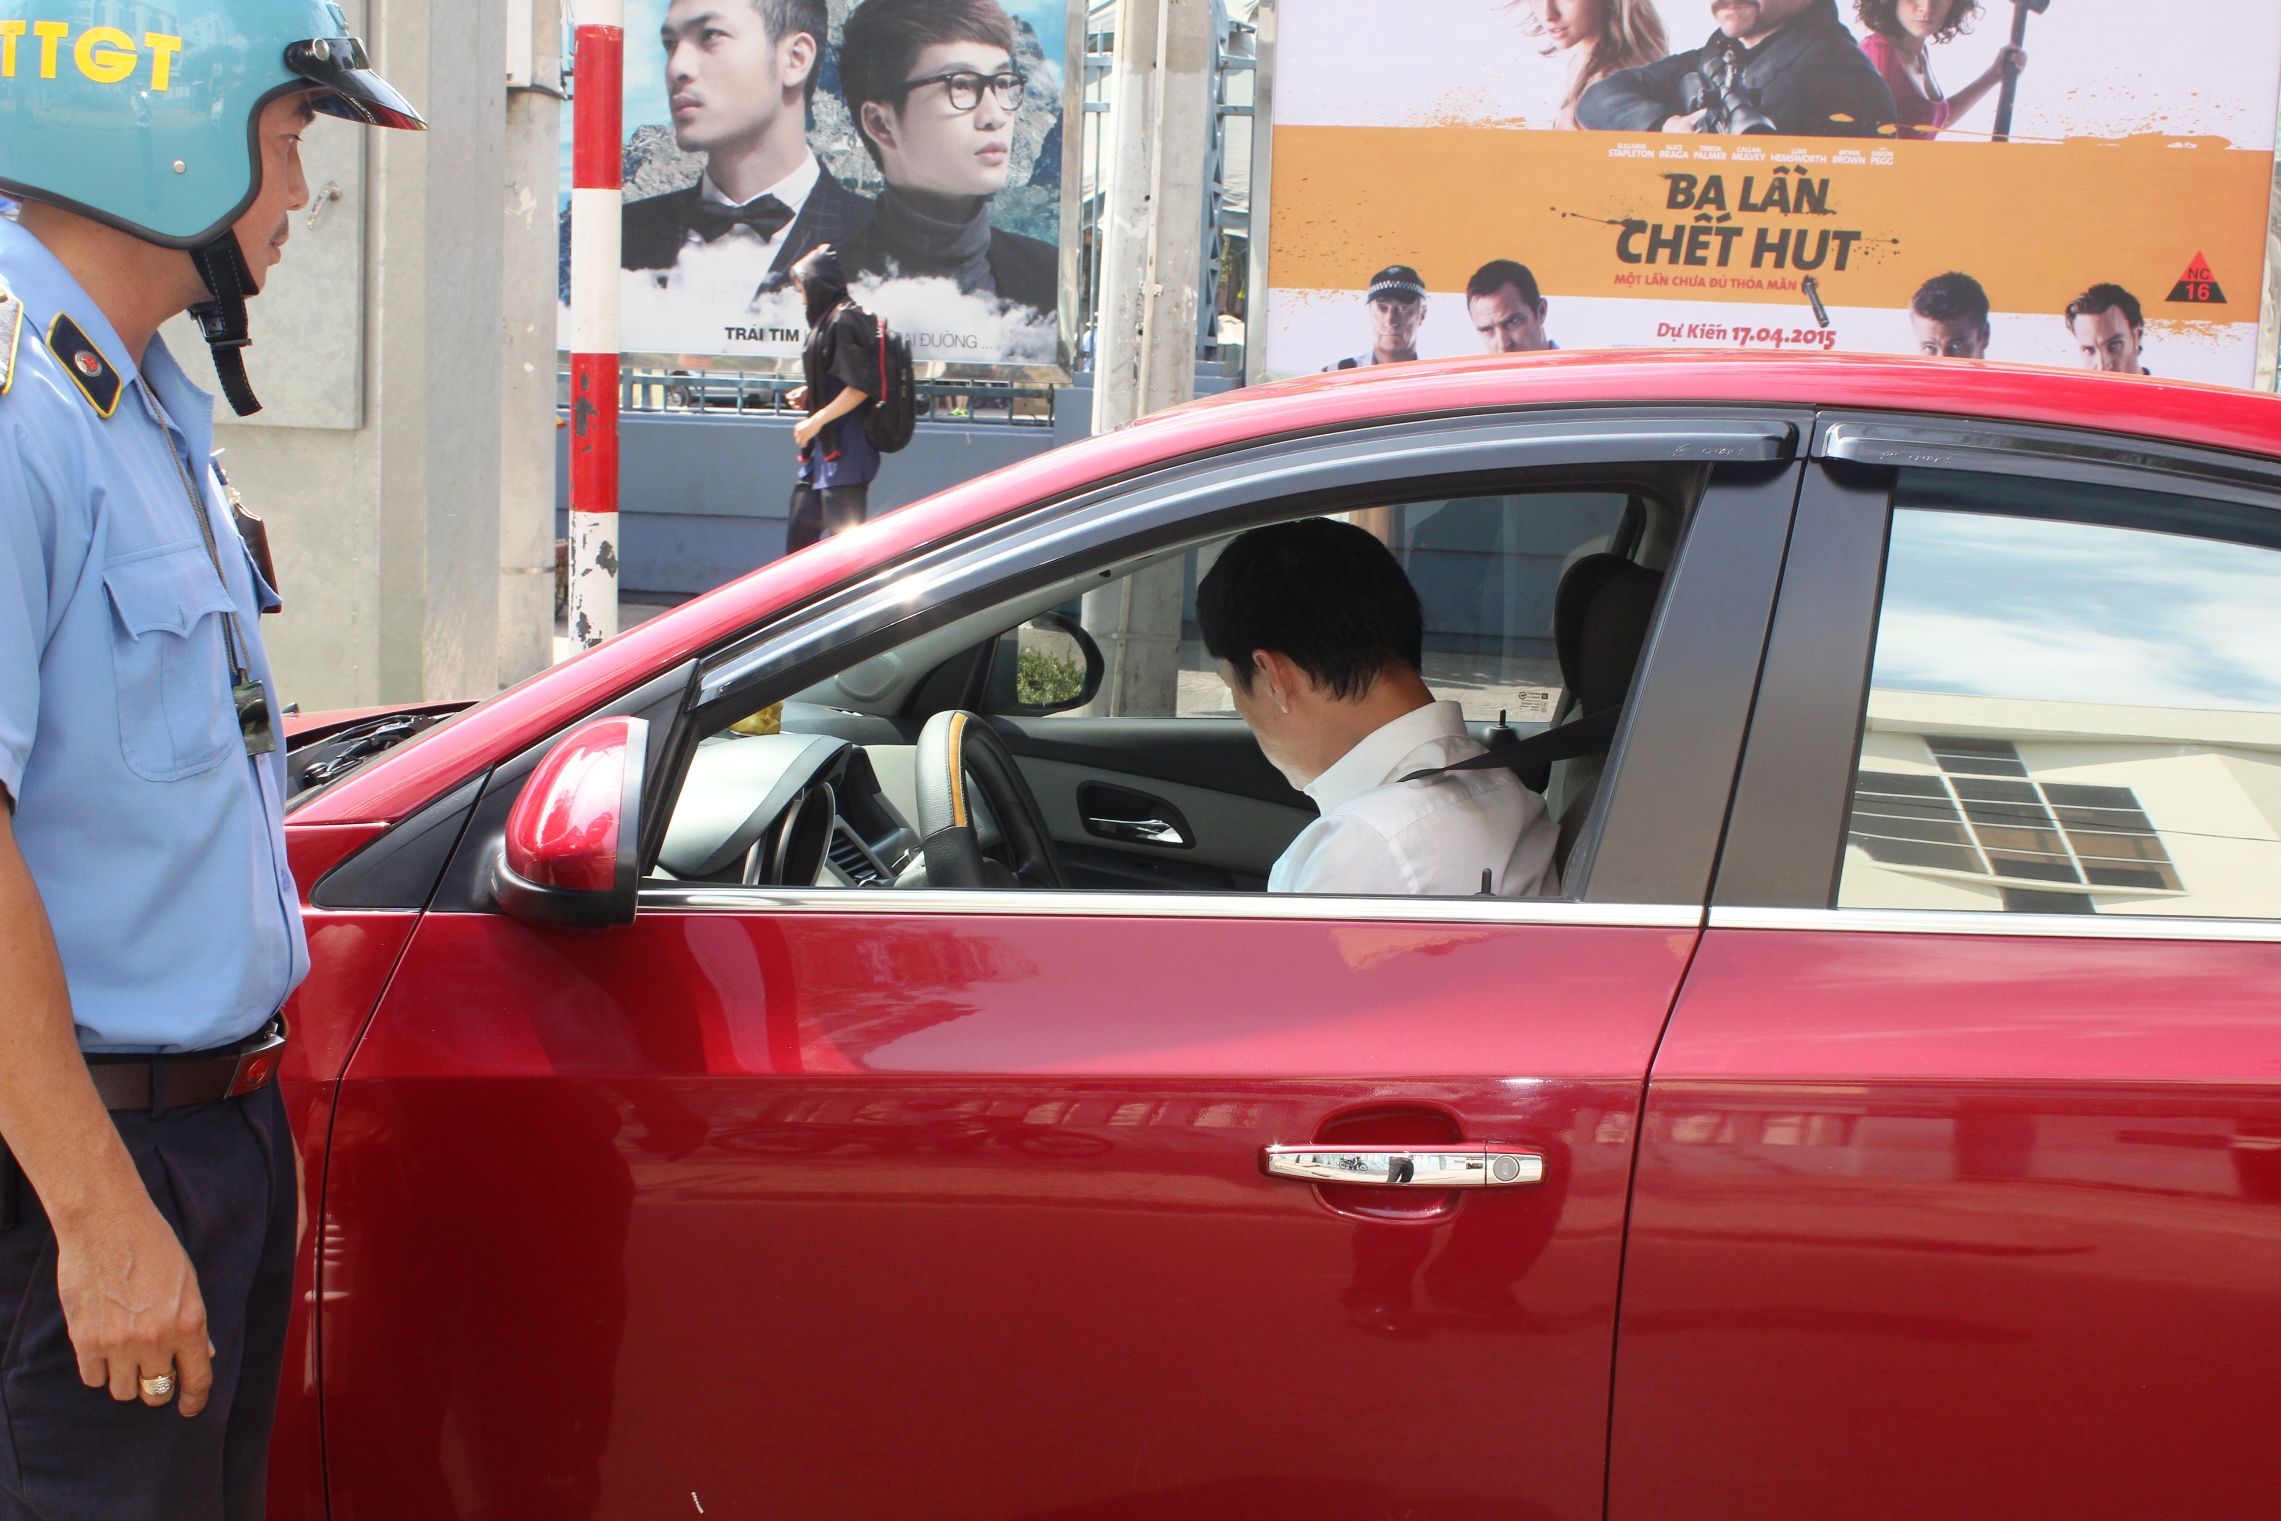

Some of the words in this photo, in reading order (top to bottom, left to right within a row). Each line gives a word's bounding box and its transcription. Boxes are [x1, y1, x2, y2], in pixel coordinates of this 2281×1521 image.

[0, 20, 182, 92] TTGT
[1608, 149, 1655, 158] STAPLETON
[1659, 151, 1689, 159] BRAGA
[1693, 152, 1727, 160] PALMER
[1731, 153, 1766, 161] MULVEY
[1770, 154, 1827, 163] HEMSWORTH
[1870, 157, 1894, 165] PEGG
[1664, 173, 1727, 211] BA
[1738, 165, 1836, 215] LẦN
[1616, 212, 1744, 268] CHẾT
[1614, 272, 1642, 288] MỘT
[1645, 272, 1669, 286] LẦN
[1672, 275, 1706, 287] CHƯA
[1767, 277, 1797, 290] MÃN
[2187, 267, 2211, 280] NC
[2185, 283, 2211, 300] 16
[724, 323, 764, 341] TRÁI
[769, 328, 799, 341] TIM
[1657, 323, 1684, 342] Dự
[1687, 324, 1727, 340] Kiến
[1732, 327, 1837, 350] 17.04.2015
